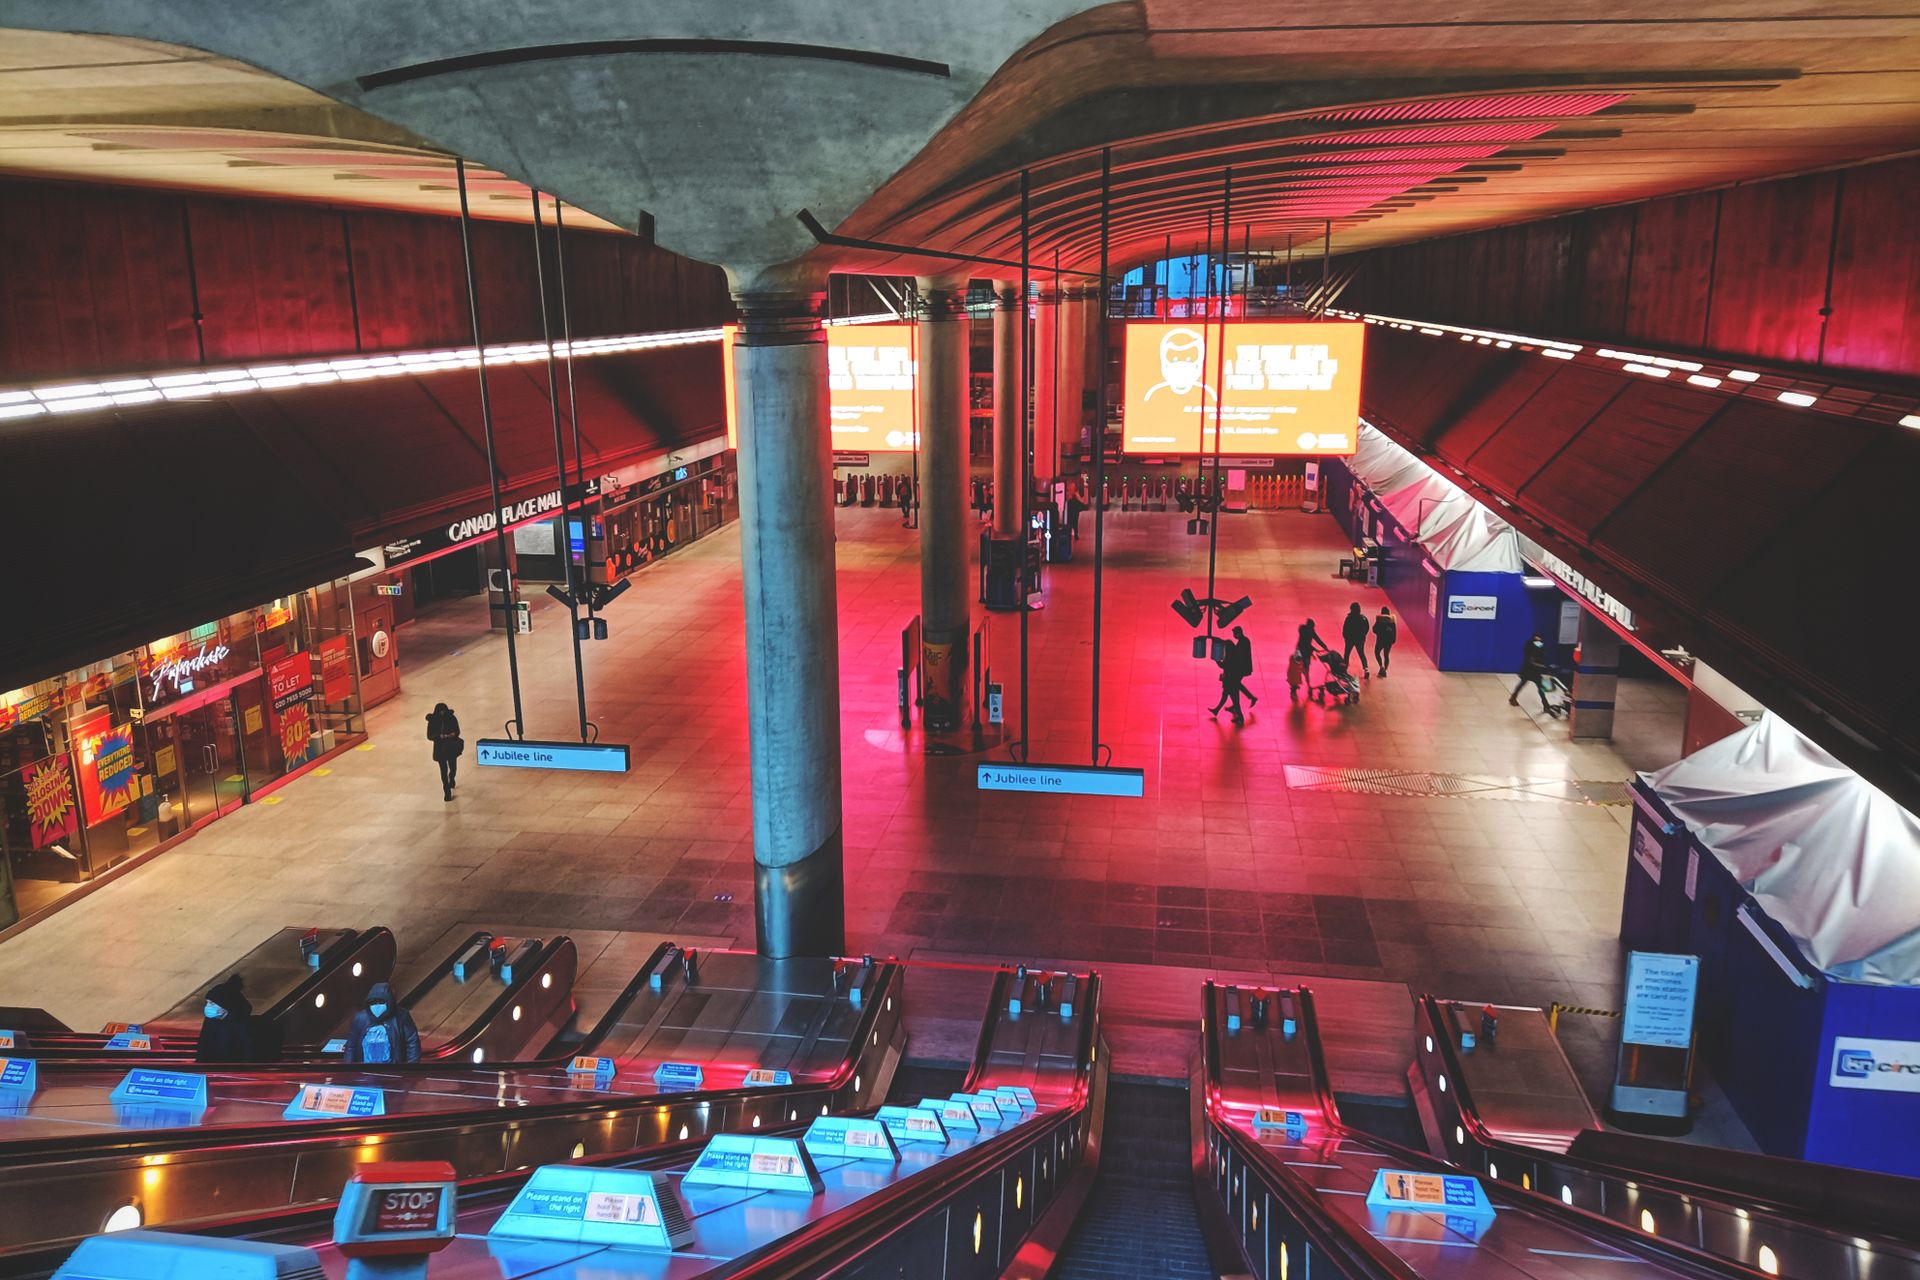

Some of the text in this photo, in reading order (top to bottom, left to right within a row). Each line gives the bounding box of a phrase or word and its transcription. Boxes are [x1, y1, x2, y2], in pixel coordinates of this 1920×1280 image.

[501, 497, 536, 524] PLACE
[272, 682, 284, 694] TO
[286, 674, 300, 689] LET
[97, 744, 131, 769] EVERYTHING
[492, 750, 553, 762] Jubilee line
[98, 755, 133, 782] REDUCED
[30, 774, 66, 804] CLOSING
[994, 774, 1062, 786] Jubilee line
[34, 784, 70, 822] DOWN
[140, 1075, 155, 1083] Stand
[174, 1078, 188, 1086] right
[384, 1192, 435, 1210] STOP
[526, 1192, 550, 1202] Please
[551, 1194, 572, 1202] stand
[549, 1203, 580, 1213] the right
